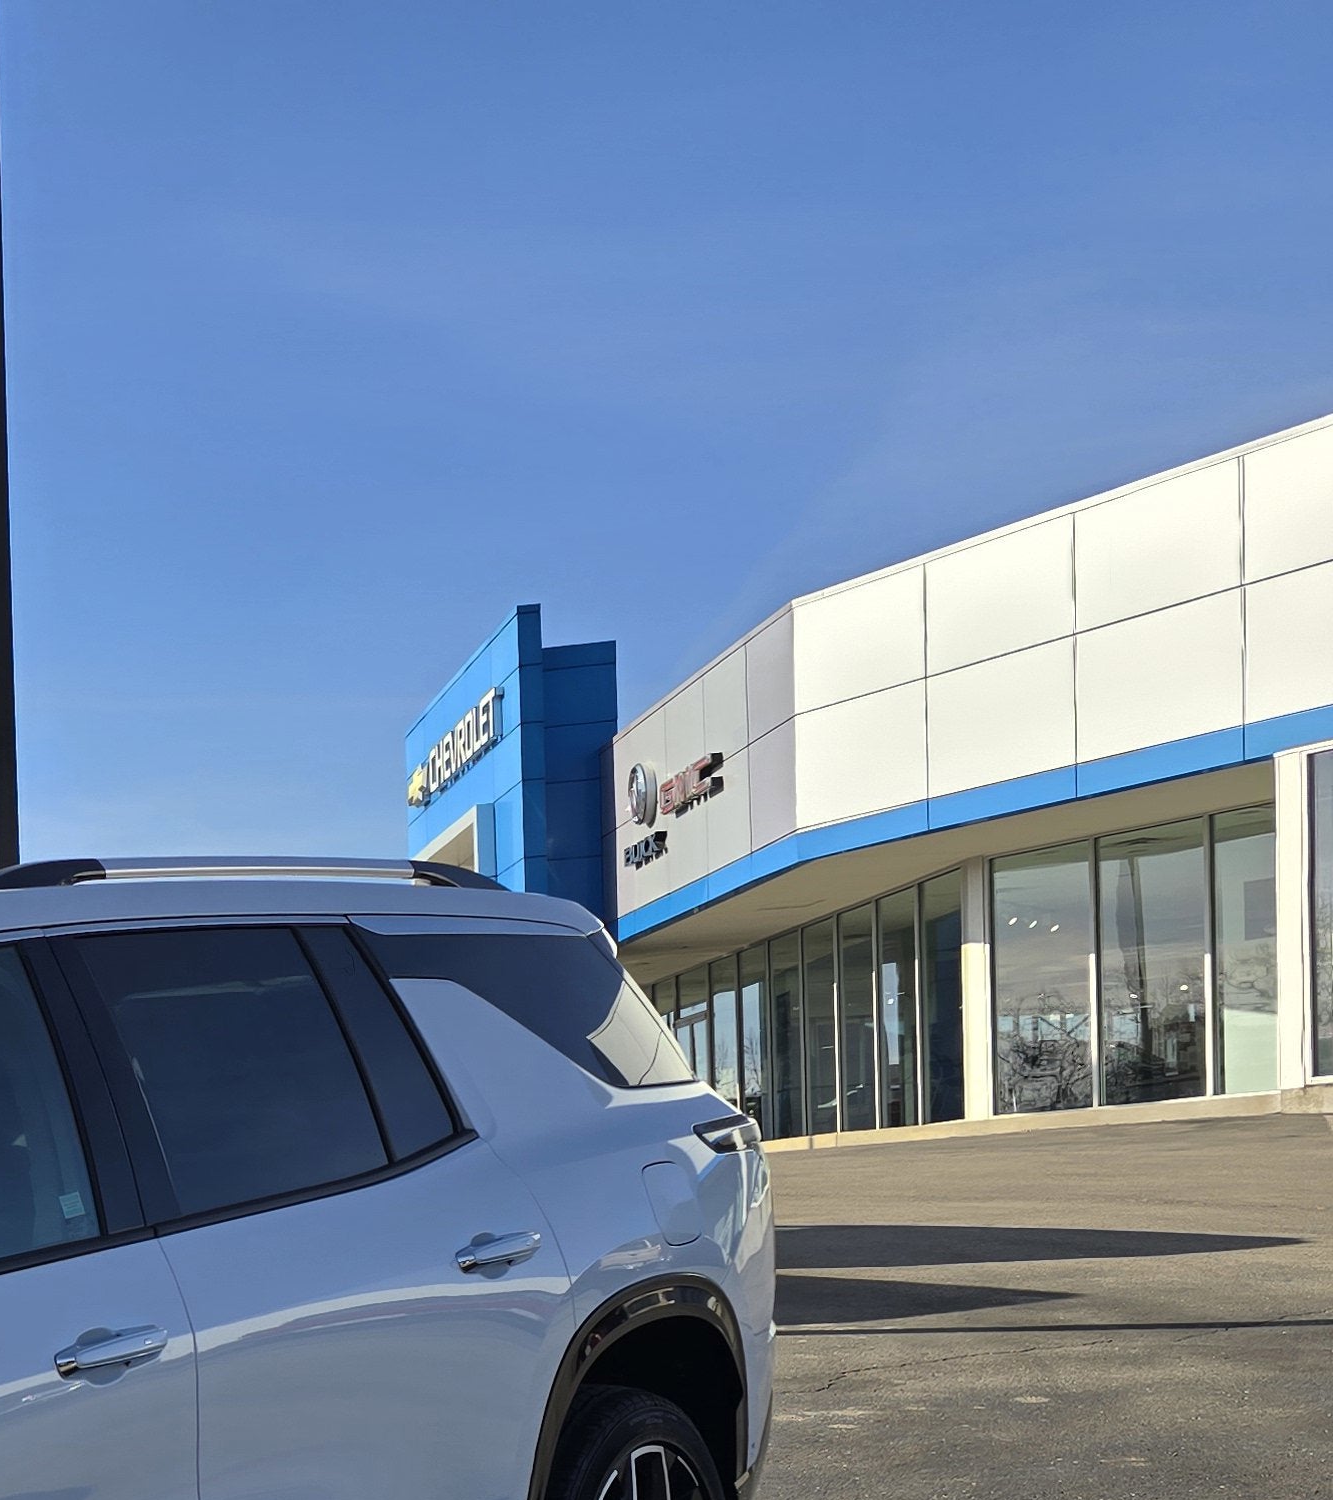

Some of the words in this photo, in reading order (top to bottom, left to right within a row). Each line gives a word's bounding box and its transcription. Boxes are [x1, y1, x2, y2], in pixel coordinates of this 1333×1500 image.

[428, 687, 502, 793] CHEVROLET
[659, 753, 719, 816] GMC
[623, 832, 664, 868] BUICK
